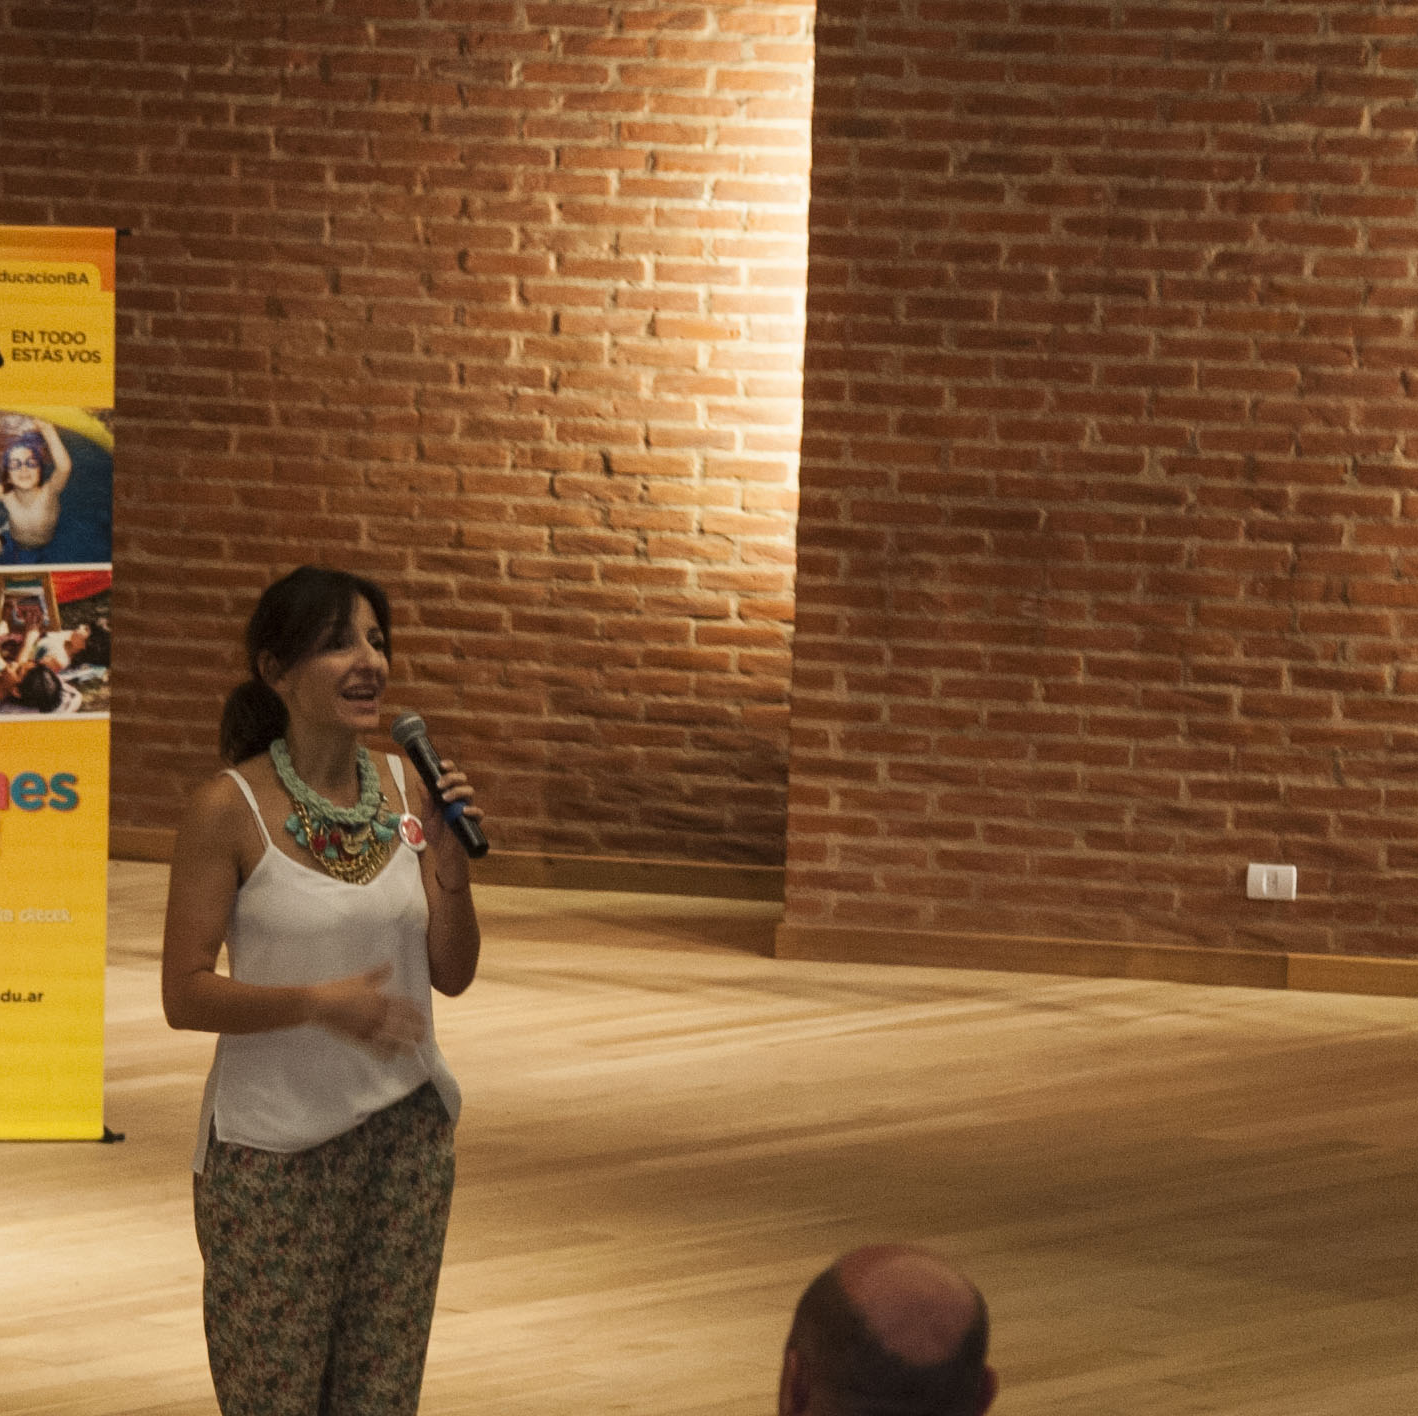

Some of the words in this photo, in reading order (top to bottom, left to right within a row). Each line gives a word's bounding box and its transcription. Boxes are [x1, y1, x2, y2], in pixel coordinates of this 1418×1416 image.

[12, 330, 35, 344] EN
[40, 330, 86, 346] TODO
[67, 349, 102, 364] VOS
